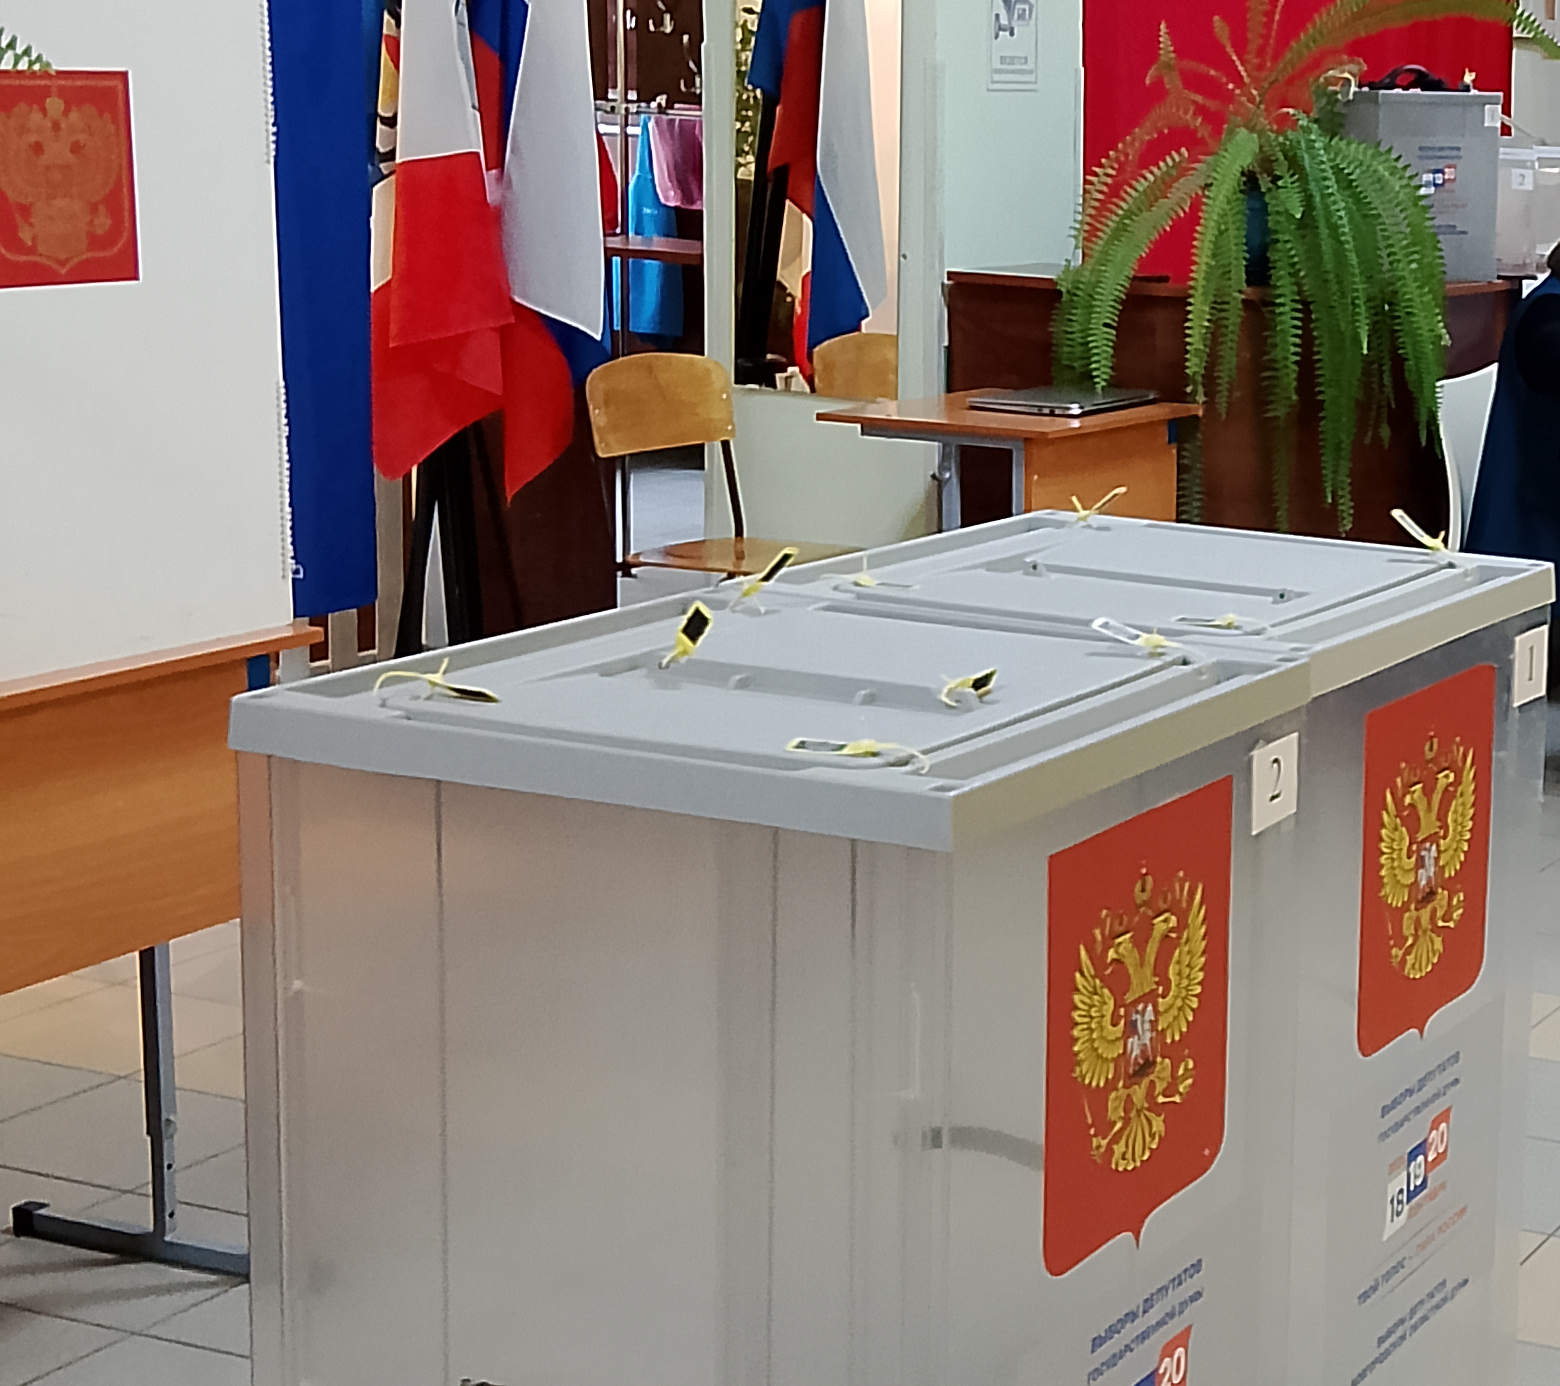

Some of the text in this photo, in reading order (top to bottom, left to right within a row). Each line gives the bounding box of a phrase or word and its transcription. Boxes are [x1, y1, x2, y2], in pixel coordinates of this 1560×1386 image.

[1526, 644, 1536, 682] 1
[1268, 755, 1284, 803] 2
[1389, 1188, 1405, 1223] 18
[1408, 1154, 1426, 1192] 19
[1427, 1122, 1448, 1162] 20
[1090, 1258, 1203, 1355] ВЫБОРЫ ДЕПУТАТОВ
